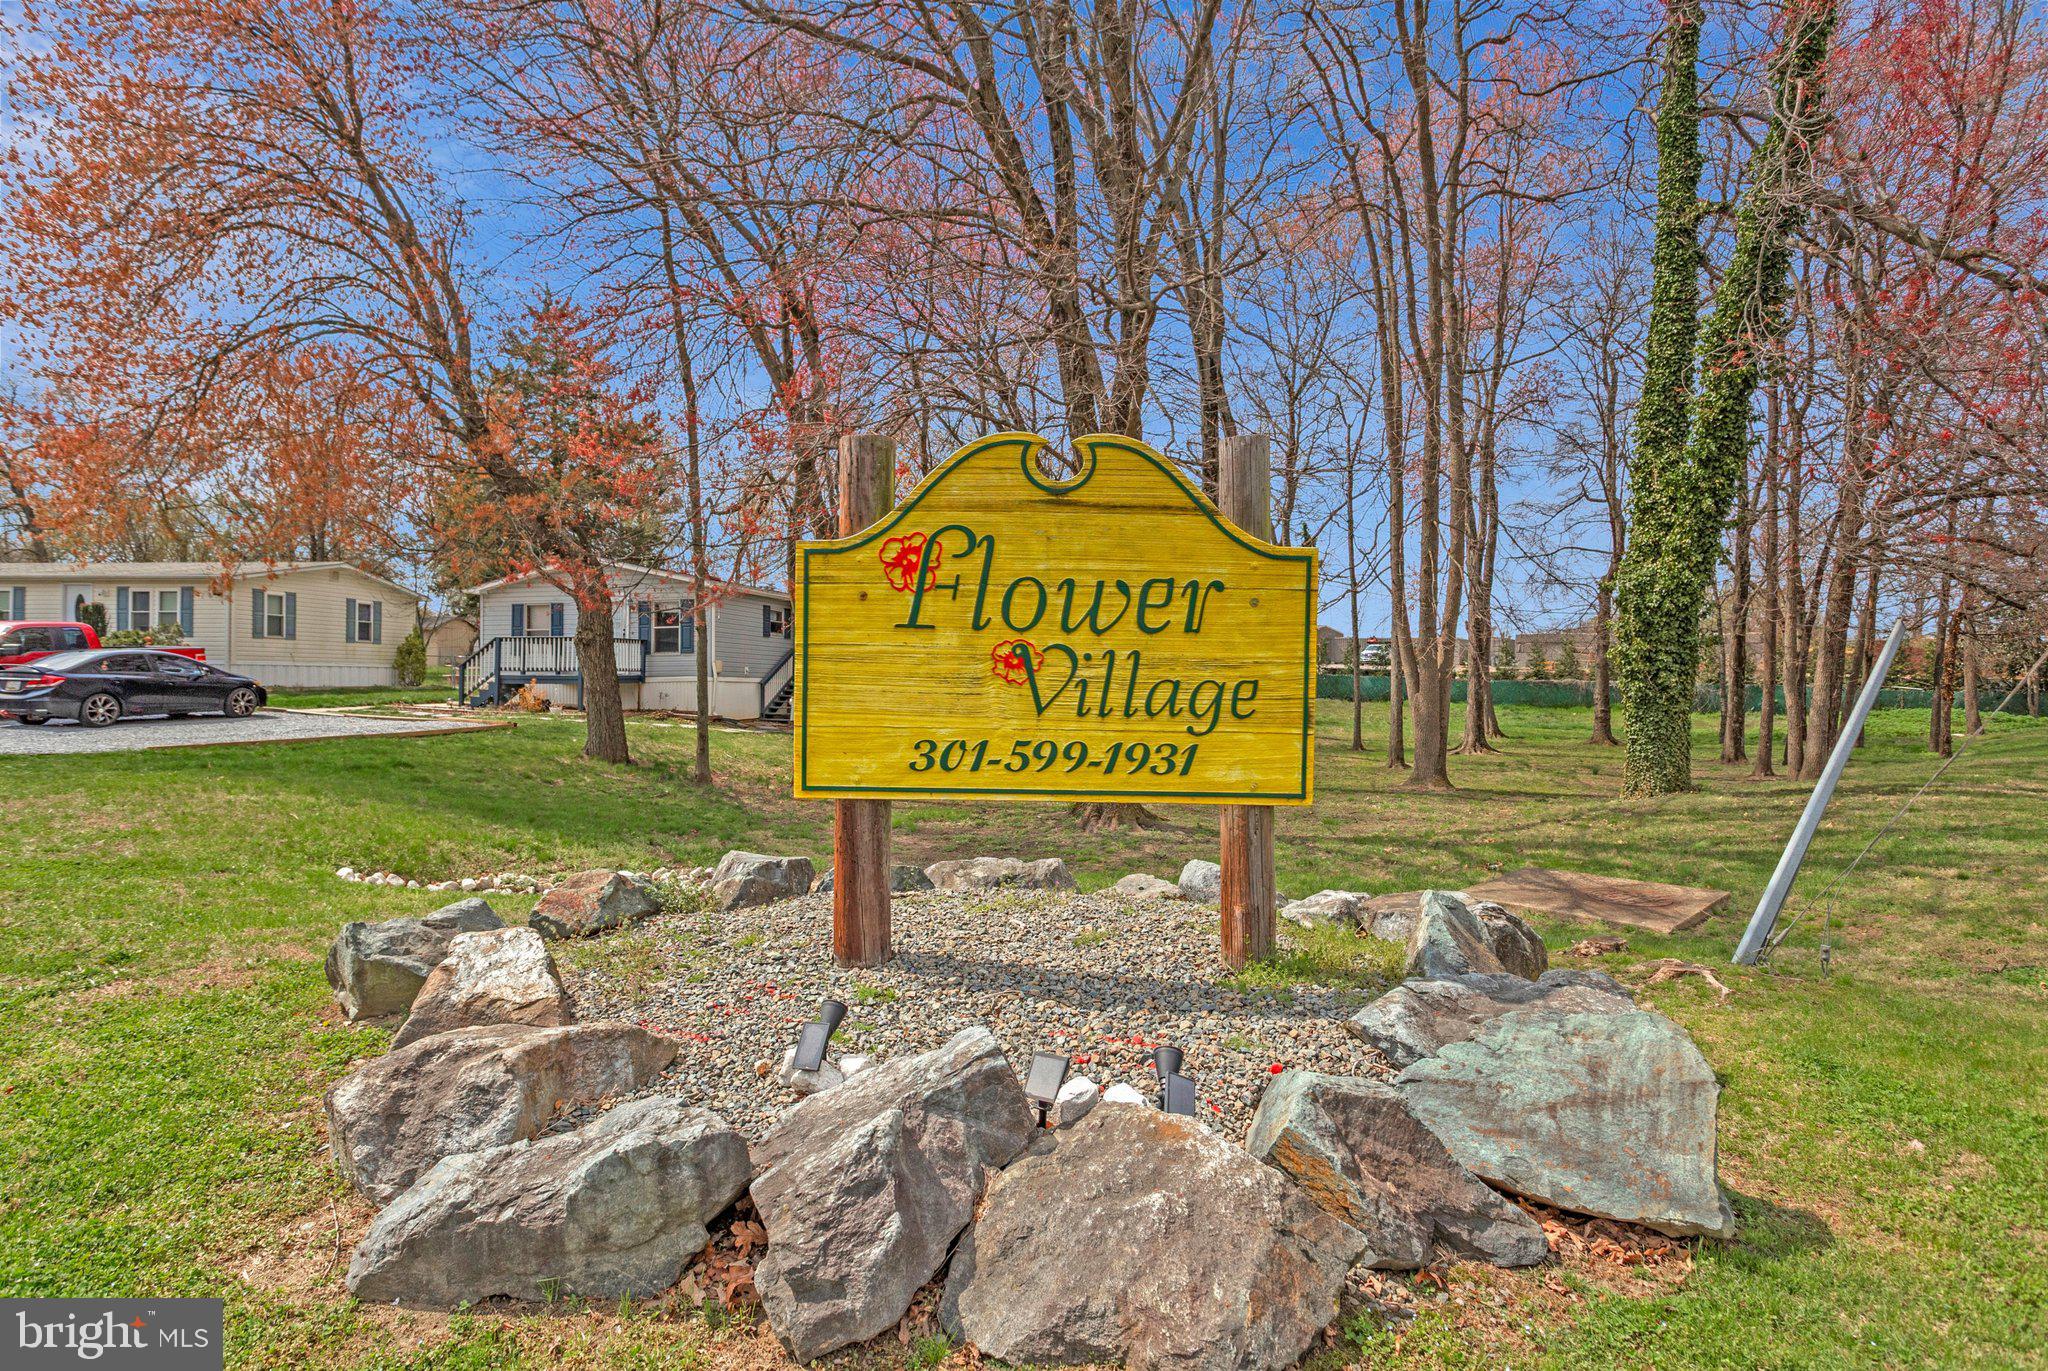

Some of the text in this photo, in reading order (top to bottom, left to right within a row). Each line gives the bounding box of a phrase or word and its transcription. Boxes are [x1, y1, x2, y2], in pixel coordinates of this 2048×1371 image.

[895, 524, 1225, 635] Flower
[1011, 643, 1259, 737] Village
[909, 739, 1199, 776] 301-599-1931
